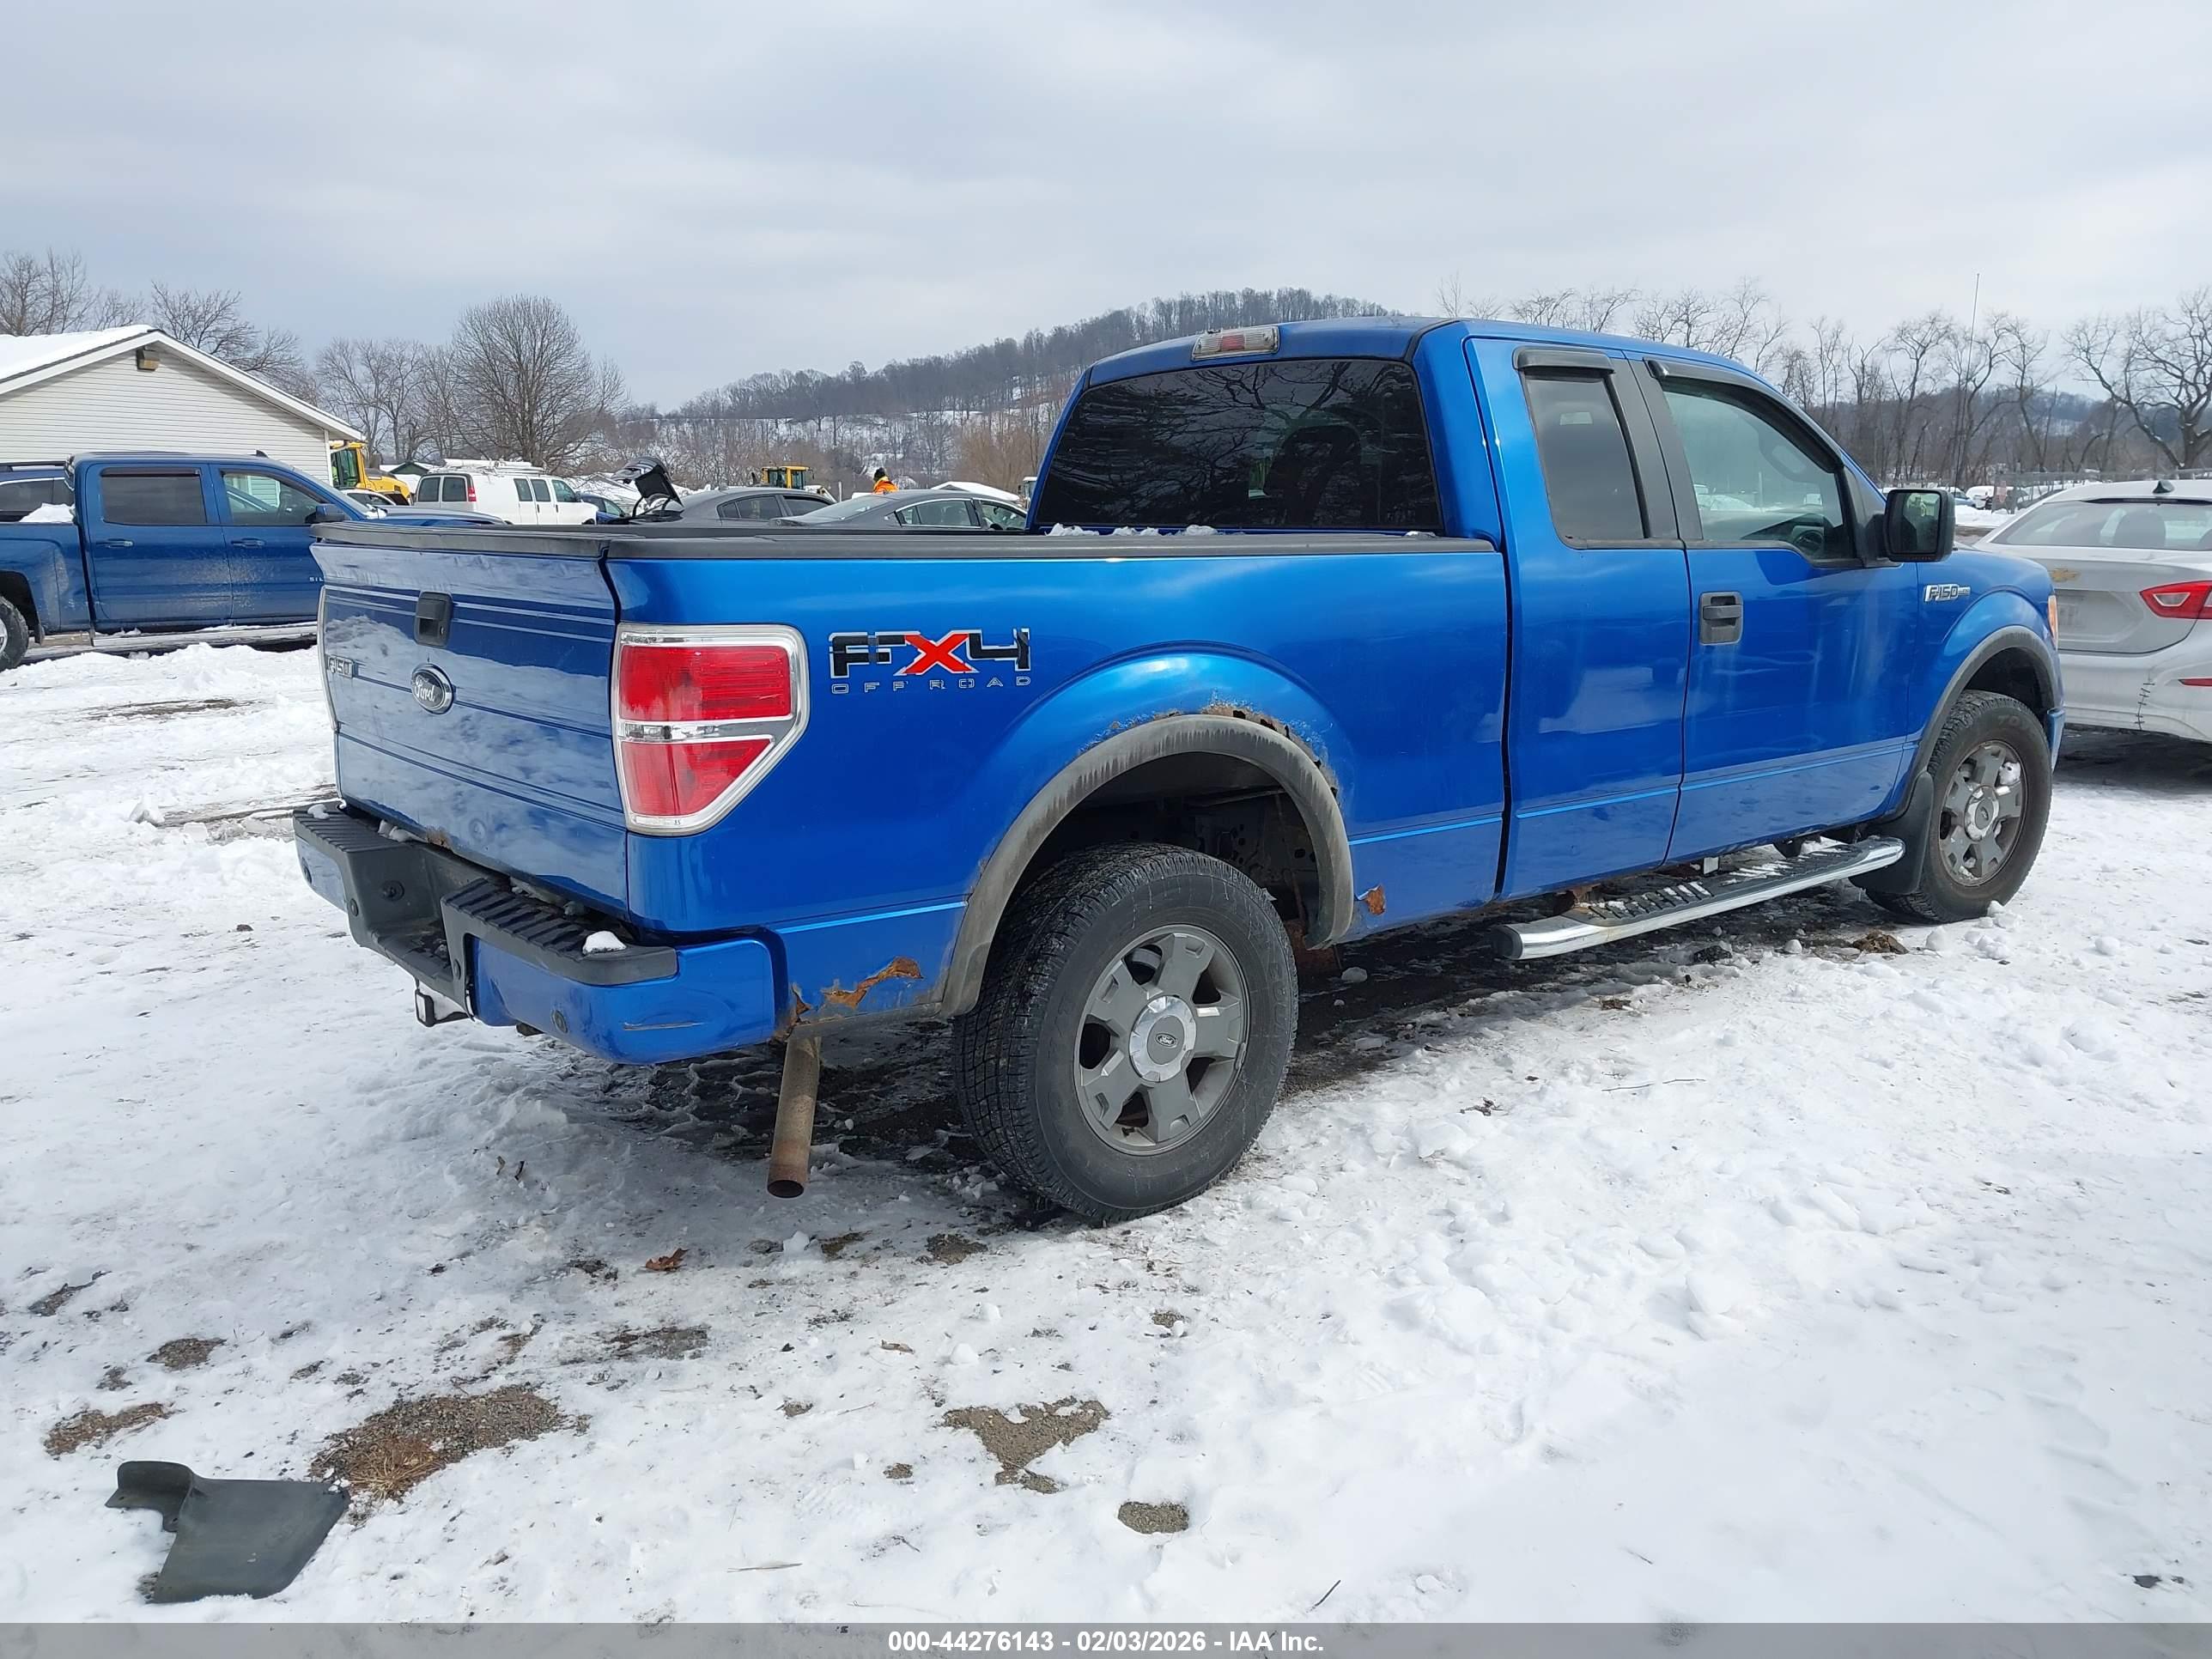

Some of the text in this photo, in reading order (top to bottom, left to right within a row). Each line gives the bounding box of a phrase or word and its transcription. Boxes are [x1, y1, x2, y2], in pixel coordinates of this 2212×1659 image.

[829, 629, 1030, 678] FX4
[414, 674, 436, 702] Ford
[831, 676, 1030, 694] OFF ROAD
